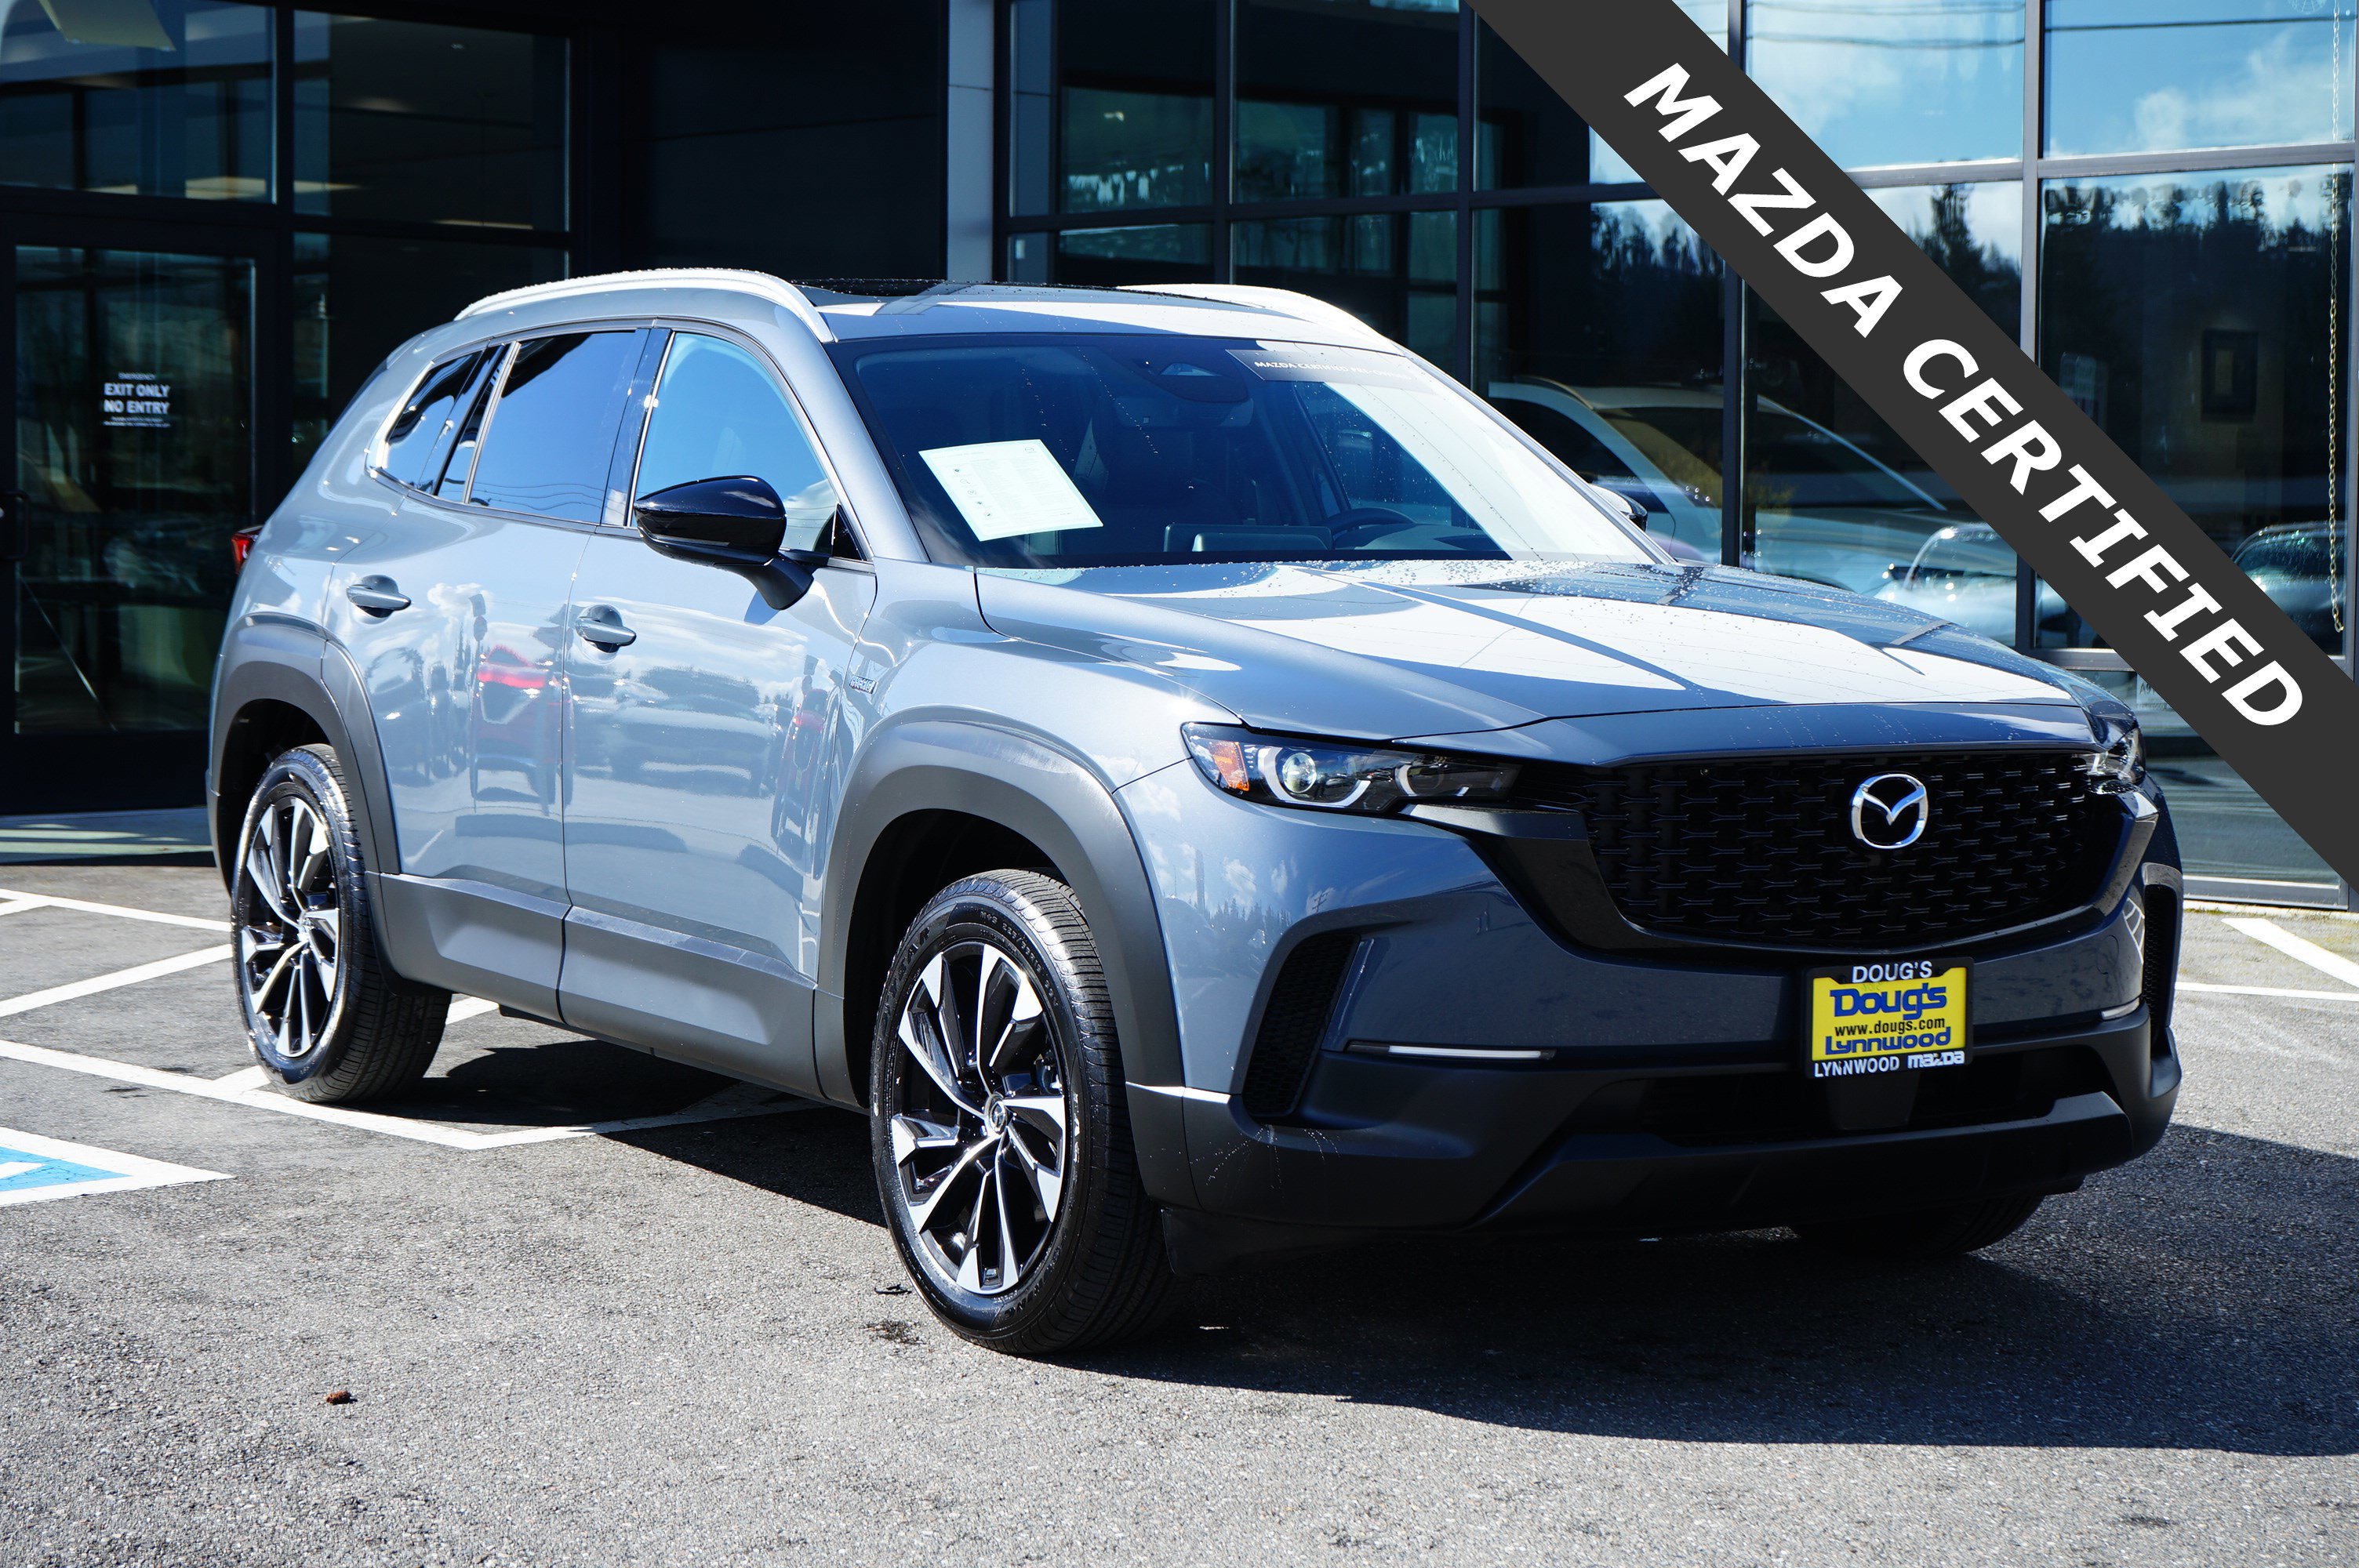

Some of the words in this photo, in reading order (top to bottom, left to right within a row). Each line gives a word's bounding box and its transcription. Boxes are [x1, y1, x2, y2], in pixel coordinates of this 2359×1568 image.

[1296, 363, 1348, 372] CERTIFIED
[104, 383, 134, 396] EXIT
[136, 384, 170, 397] ONLY
[104, 400, 124, 413] NO
[127, 401, 170, 414] ENTRY
[1852, 960, 1932, 983] DOUG'S
[1830, 982, 1946, 1020] Doug's
[1834, 1018, 1945, 1037] www.dougs.com
[1825, 1026, 1951, 1055] Lynnwood
[1814, 1056, 1900, 1077] LYNNWOOD
